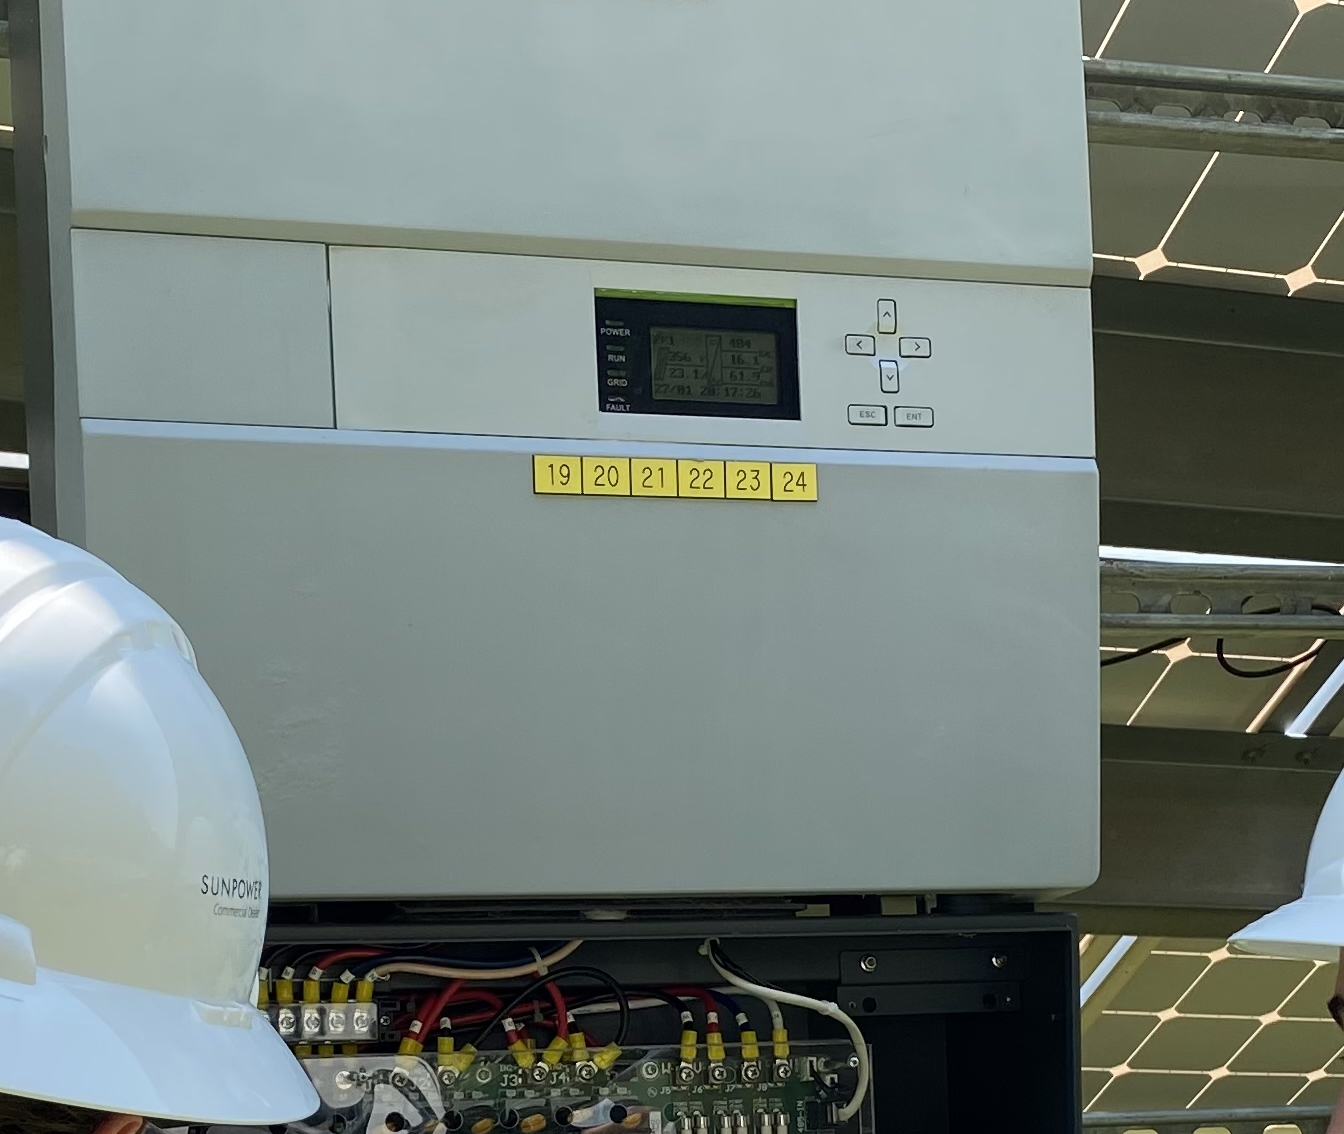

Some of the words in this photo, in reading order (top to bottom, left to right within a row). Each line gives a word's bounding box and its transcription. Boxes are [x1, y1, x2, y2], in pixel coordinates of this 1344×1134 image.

[600, 328, 631, 337] POWER
[608, 354, 626, 362] RUN
[668, 351, 691, 363] 356
[607, 378, 628, 387] GRID
[606, 404, 631, 412] FAULT
[547, 463, 571, 486] 19
[594, 465, 619, 487] 20
[642, 467, 664, 488] 21
[689, 468, 714, 490] 22
[736, 469, 761, 491] 23
[783, 471, 807, 493] 24
[201, 874, 262, 900] SUNPOWER
[500, 1074, 519, 1087] J3
[549, 1072, 567, 1085] J4
[660, 1086, 671, 1094] J5
[692, 1086, 703, 1094] J6
[725, 1085, 735, 1093] J7
[757, 1083, 768, 1092] J8
